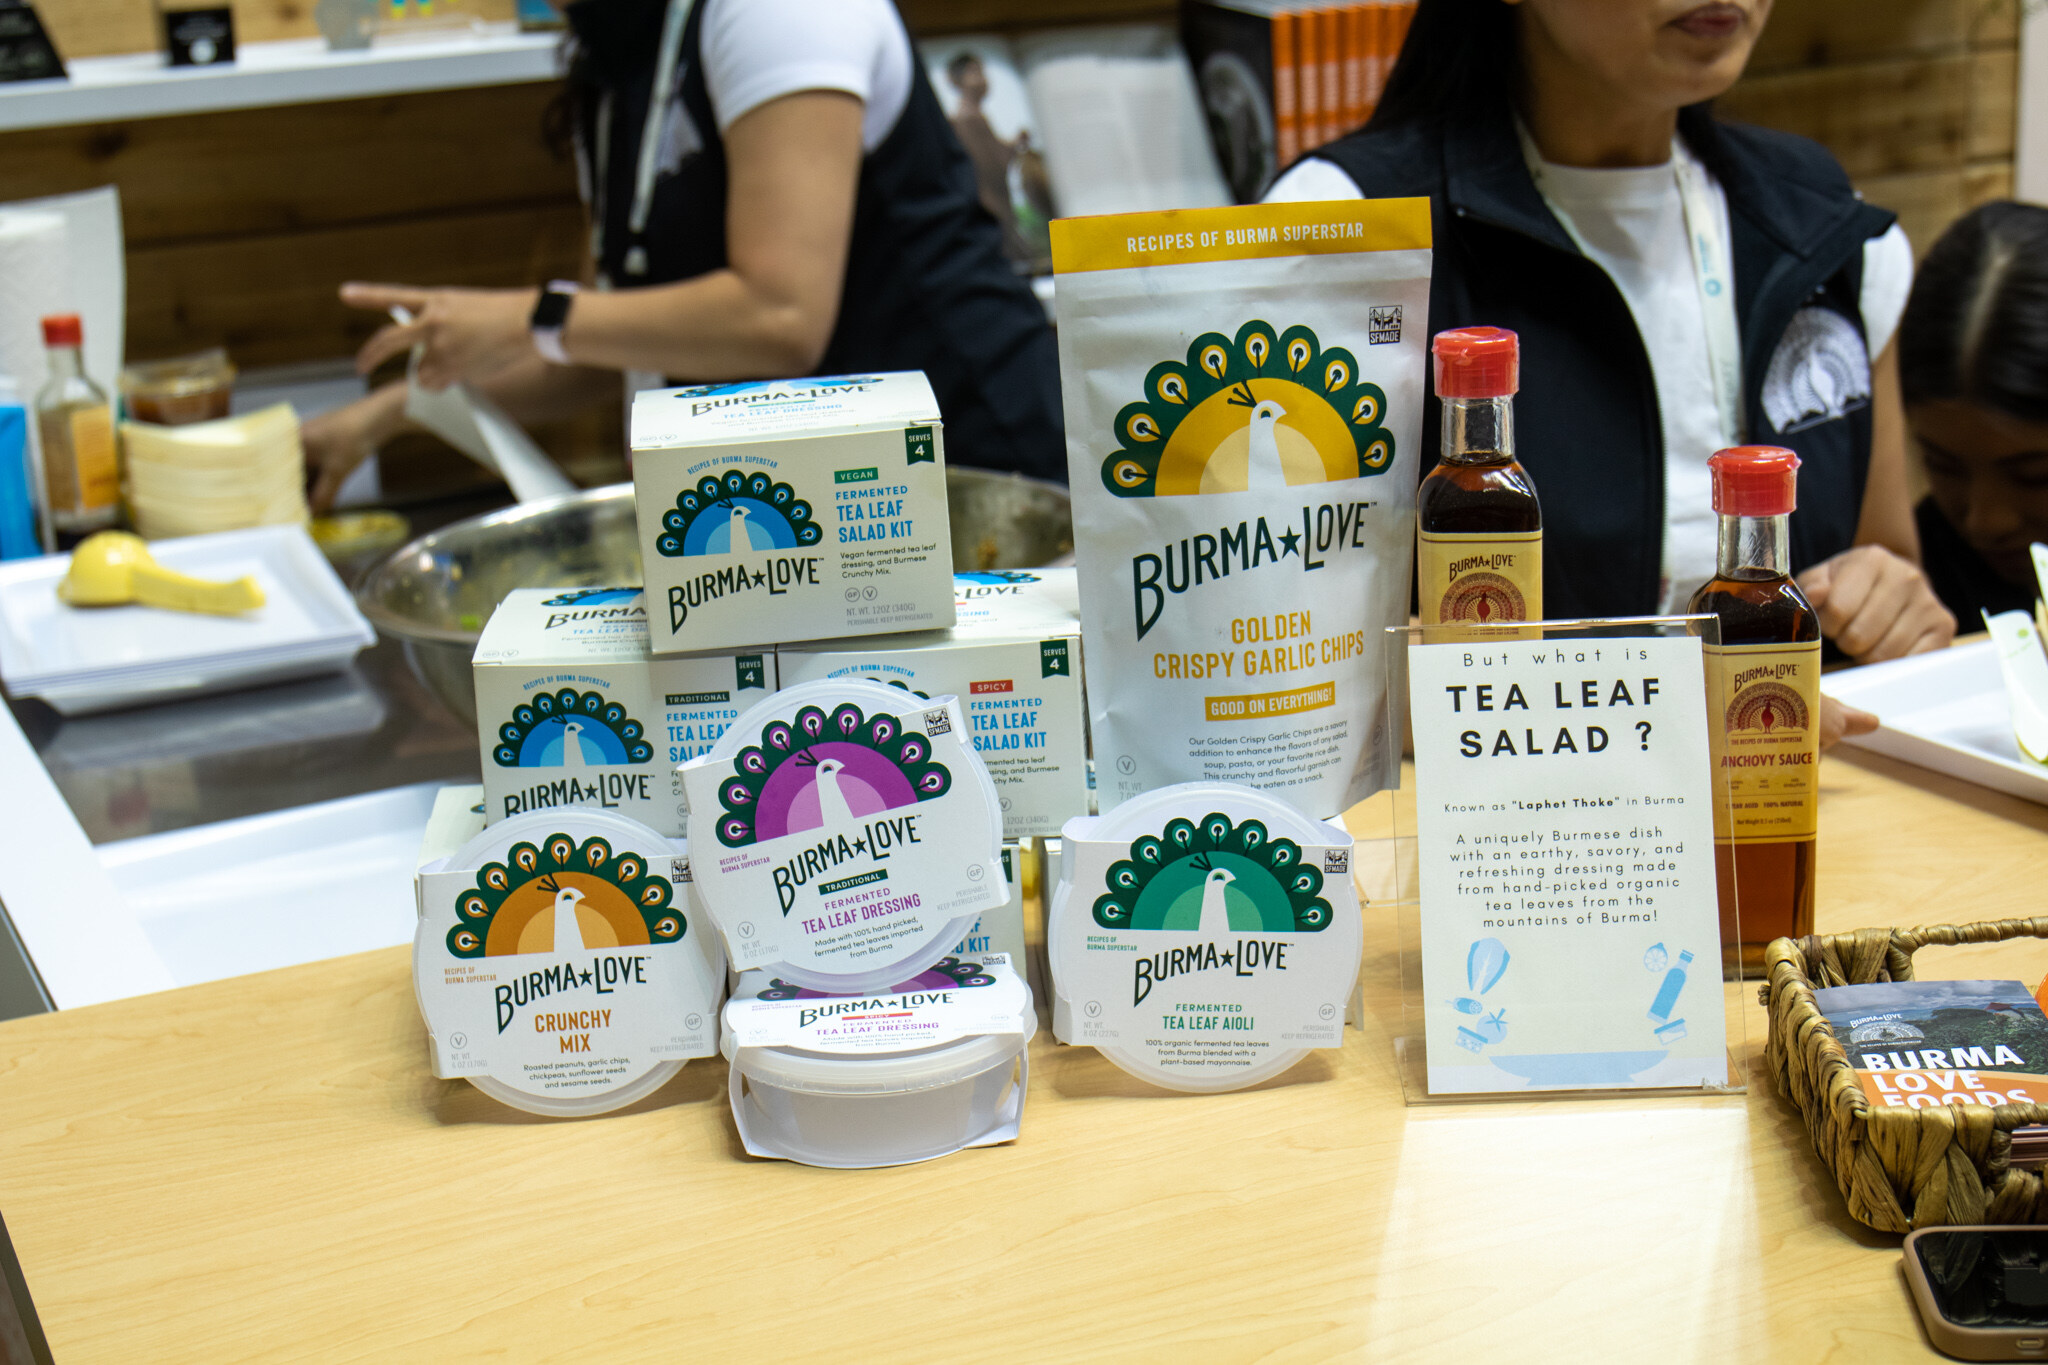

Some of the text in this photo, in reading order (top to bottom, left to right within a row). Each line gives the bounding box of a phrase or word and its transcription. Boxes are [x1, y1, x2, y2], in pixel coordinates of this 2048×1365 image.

[1126, 221, 1364, 254] RECIPES OF BURMA SUPERSTAR
[1370, 331, 1401, 345] SFMADE
[692, 385, 872, 418] BURMA LOVE
[908, 433, 931, 443] SERVES
[914, 444, 925, 456] 4
[840, 470, 873, 481] VEGAN
[835, 485, 908, 500] FERMENTED
[836, 499, 903, 522] TEA LEAF
[838, 520, 913, 543] SALAD KIT
[840, 543, 937, 560] Vegan fermented tea leaf
[841, 555, 927, 569] dressing, and Burmese
[1449, 554, 1514, 584] BURMA LOVE
[842, 568, 892, 579] Crunchy Mix.
[1132, 501, 1370, 643] BURMA LOVE
[667, 557, 821, 636] BURMA LOVE
[965, 586, 1025, 599] LOVE
[544, 607, 647, 630] BURMA
[1231, 609, 1312, 645] GOLDEN
[1043, 647, 1067, 657] SERVES
[1153, 629, 1365, 680] CRISPY GARLIC CHIPS
[1463, 648, 1648, 667] But what is
[738, 660, 761, 670] SERVES
[1049, 658, 1060, 670] 4
[745, 671, 755, 683] 4
[1734, 664, 1798, 693] BURMA LOVE
[977, 683, 1008, 692] SPICY
[1446, 678, 1660, 713] TEA LEAF
[668, 694, 728, 704] TRADITIONAL
[970, 697, 1043, 711] FERMENTED
[1210, 687, 1332, 716] GOOD ON EVERYTHING!
[666, 709, 738, 722] FERMENTED
[971, 711, 1038, 731] TEA LEAF
[973, 731, 1047, 752] SALAD KIT
[1459, 721, 1653, 758] SALAD ?
[1720, 752, 1812, 768] ANCHOVY SAUCE
[503, 773, 651, 819] BURMA LOVE
[1444, 802, 1486, 813] Known
[1491, 803, 1506, 812] as
[1626, 797, 1639, 807] in
[1644, 795, 1686, 807] Burma
[1456, 826, 1664, 847] A uniquely Burmese dish
[1449, 842, 1685, 862] with an earthy, savory, and
[772, 814, 922, 918] BURMA LOVE
[1325, 864, 1348, 873] SFMADE
[1458, 860, 1677, 881] refreshing dressing made
[825, 872, 881, 892] TRADITIONAL
[1457, 877, 1681, 896] from hand-picked organic
[825, 887, 891, 911] FERMENTED
[1485, 895, 1655, 911] tea leaves from the
[801, 893, 922, 935] TEA LEAF DRESSING
[1483, 910, 1659, 928] mountains of Burma!
[814, 916, 919, 947] Made with 100% hand picked,
[814, 925, 924, 957] fermented tea leaves imported
[849, 943, 893, 959] from Burma
[1134, 938, 1288, 1008] BURMA LOVE
[494, 955, 648, 1036] BURMA LOVE
[800, 993, 954, 1028] BURMA LOVE
[1175, 1003, 1243, 1013] FERMENTED
[534, 1008, 612, 1033] CRUNCHY
[1162, 1016, 1254, 1031] TEA LEAF AIOLI
[1850, 1013, 1902, 1029] BURMA LOVE
[559, 1033, 591, 1054] MIX
[1164, 1040, 1192, 1048] organic
[1193, 1039, 1231, 1048] fermented
[1246, 1040, 1270, 1048] leaves
[1202, 1049, 1233, 1057] blended
[523, 1056, 631, 1071] Roasted peanuts, garlic chips,
[1206, 1060, 1252, 1068] mayonnaise.
[1861, 1044, 2025, 1072] BURMA
[529, 1066, 626, 1081] chickpeas, sunflower seeds
[544, 1077, 613, 1089] and sesame seeds.
[1872, 1070, 1985, 1093] LOVE
[1883, 1088, 2035, 1108] FOODS
